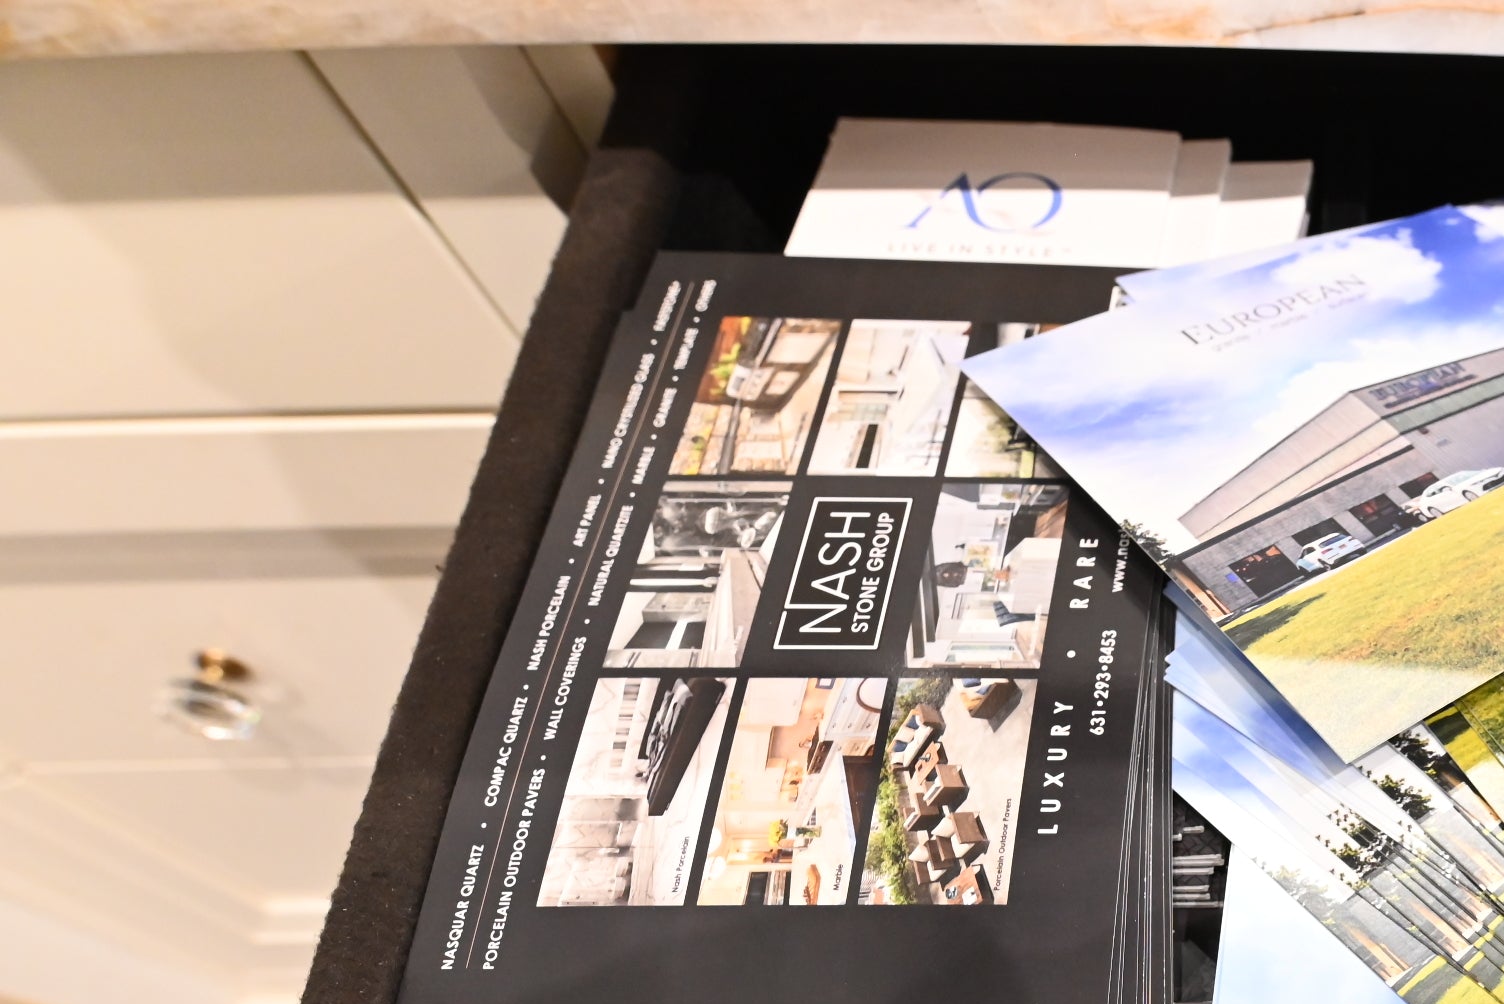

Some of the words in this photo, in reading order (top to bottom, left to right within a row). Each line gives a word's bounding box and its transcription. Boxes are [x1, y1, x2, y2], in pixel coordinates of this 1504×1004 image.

[1181, 273, 1367, 345] EUROPEAN
[786, 511, 871, 633] NASH
[850, 576, 880, 633] STONE
[866, 512, 895, 572] GROUP
[1111, 529, 1130, 593] www.nas
[1037, 701, 1074, 834] LUXURY
[1069, 538, 1099, 609] RARE
[441, 900, 470, 970] NASQUAR
[461, 844, 485, 897] QUARTZ
[484, 746, 512, 807] COMPAC
[503, 697, 528, 744] QUARTZ
[527, 639, 548, 670] NASH
[539, 576, 571, 637] PORCELAIN
[482, 891, 513, 970] PORCELAIN
[503, 820, 531, 888] OUTDOOR
[521, 768, 546, 817] PAVERS
[543, 708, 564, 740] WALL
[554, 636, 587, 706] COVERINGS
[588, 558, 614, 606] NATURAL
[605, 505, 634, 557] QUARTZITE
[672, 873, 681, 893] Nash
[676, 836, 690, 872] Porcelain
[833, 864, 844, 890] Marble
[994, 855, 1004, 891] Porcelain
[999, 823, 1008, 853] Outdoor
